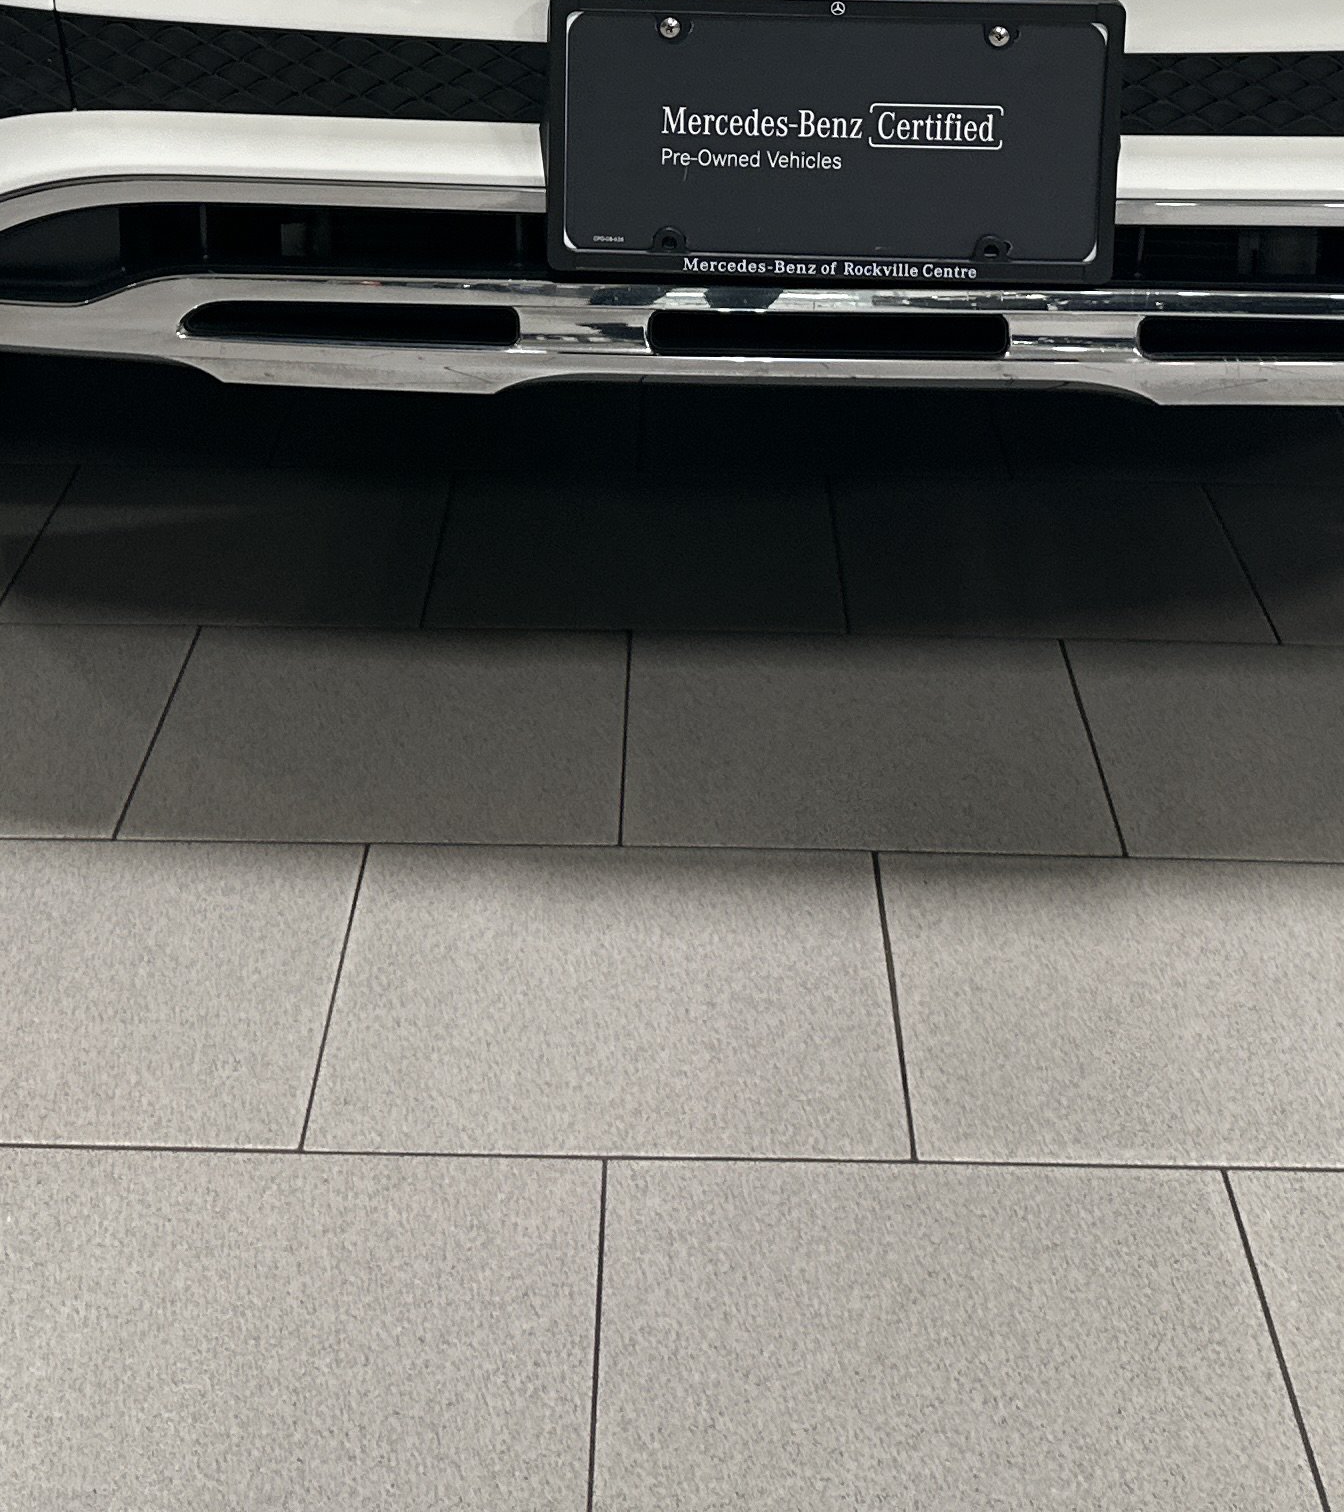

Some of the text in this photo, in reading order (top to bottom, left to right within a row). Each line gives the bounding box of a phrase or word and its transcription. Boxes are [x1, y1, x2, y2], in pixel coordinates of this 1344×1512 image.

[660, 106, 996, 144] Mercedes-Benz Certified
[660, 148, 842, 170] Pre-Owned Vehicles
[683, 257, 977, 280] Mercedes-Benz of Rockville Centre
